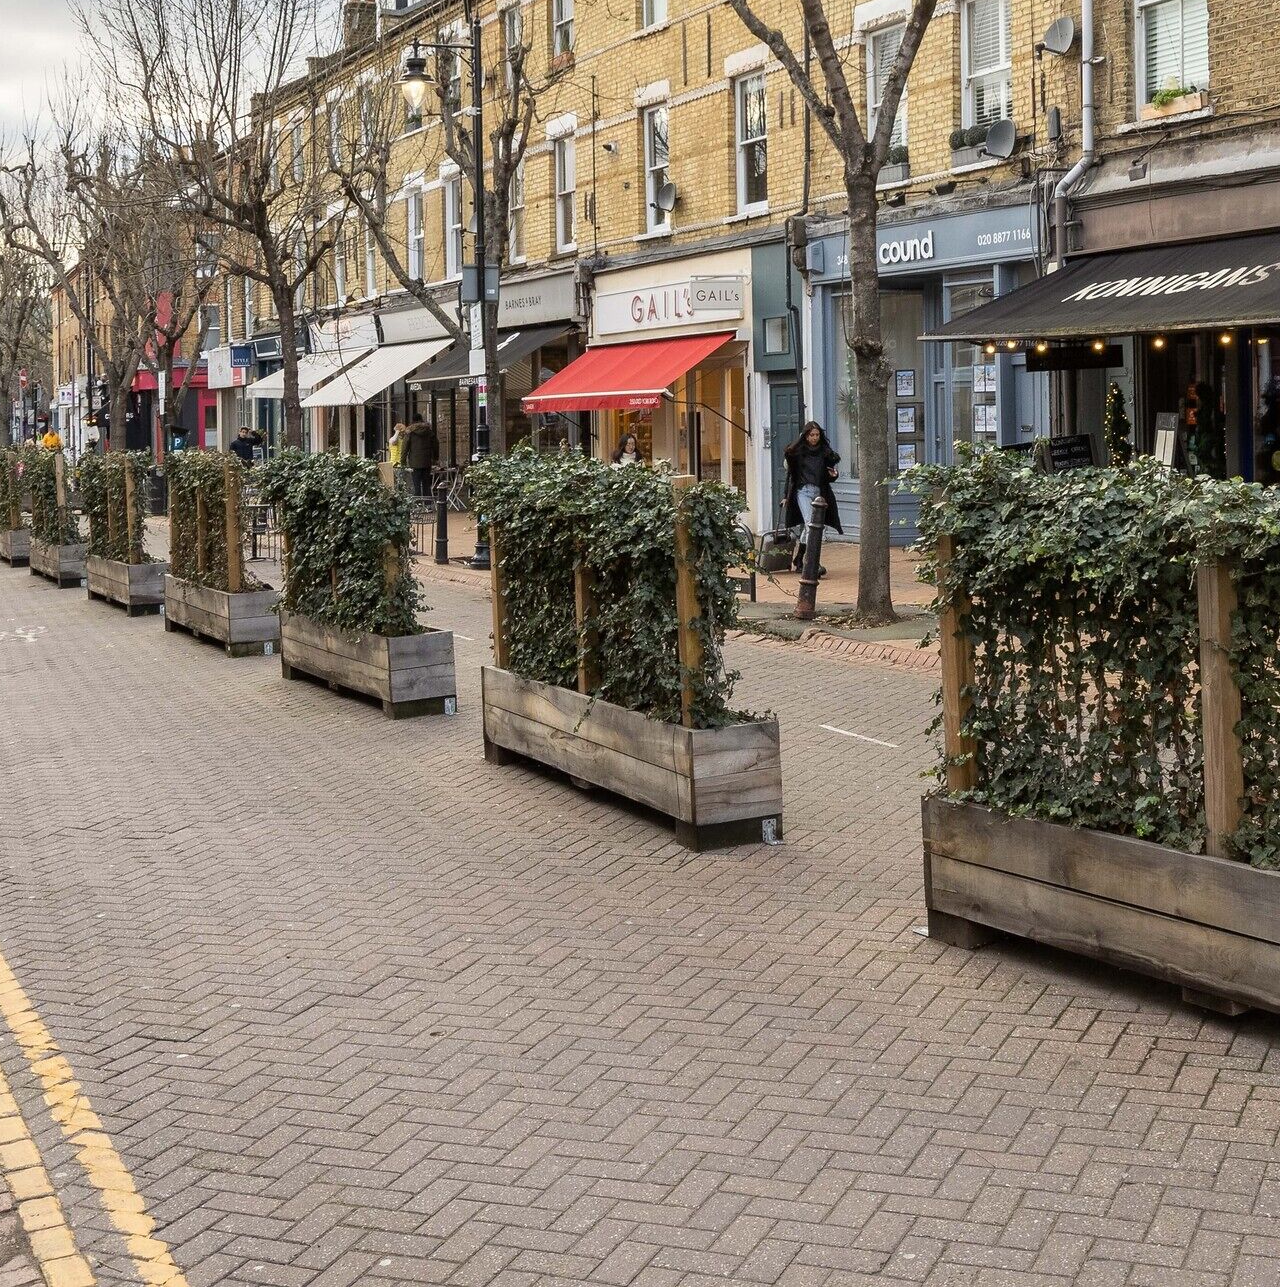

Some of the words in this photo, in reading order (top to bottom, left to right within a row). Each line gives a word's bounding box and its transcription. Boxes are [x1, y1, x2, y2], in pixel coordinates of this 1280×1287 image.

[977, 233, 992, 246] 020
[993, 231, 1011, 244] 8877
[1013, 228, 1031, 241] 1166
[878, 230, 934, 264] cound
[174, 437, 181, 447] P
